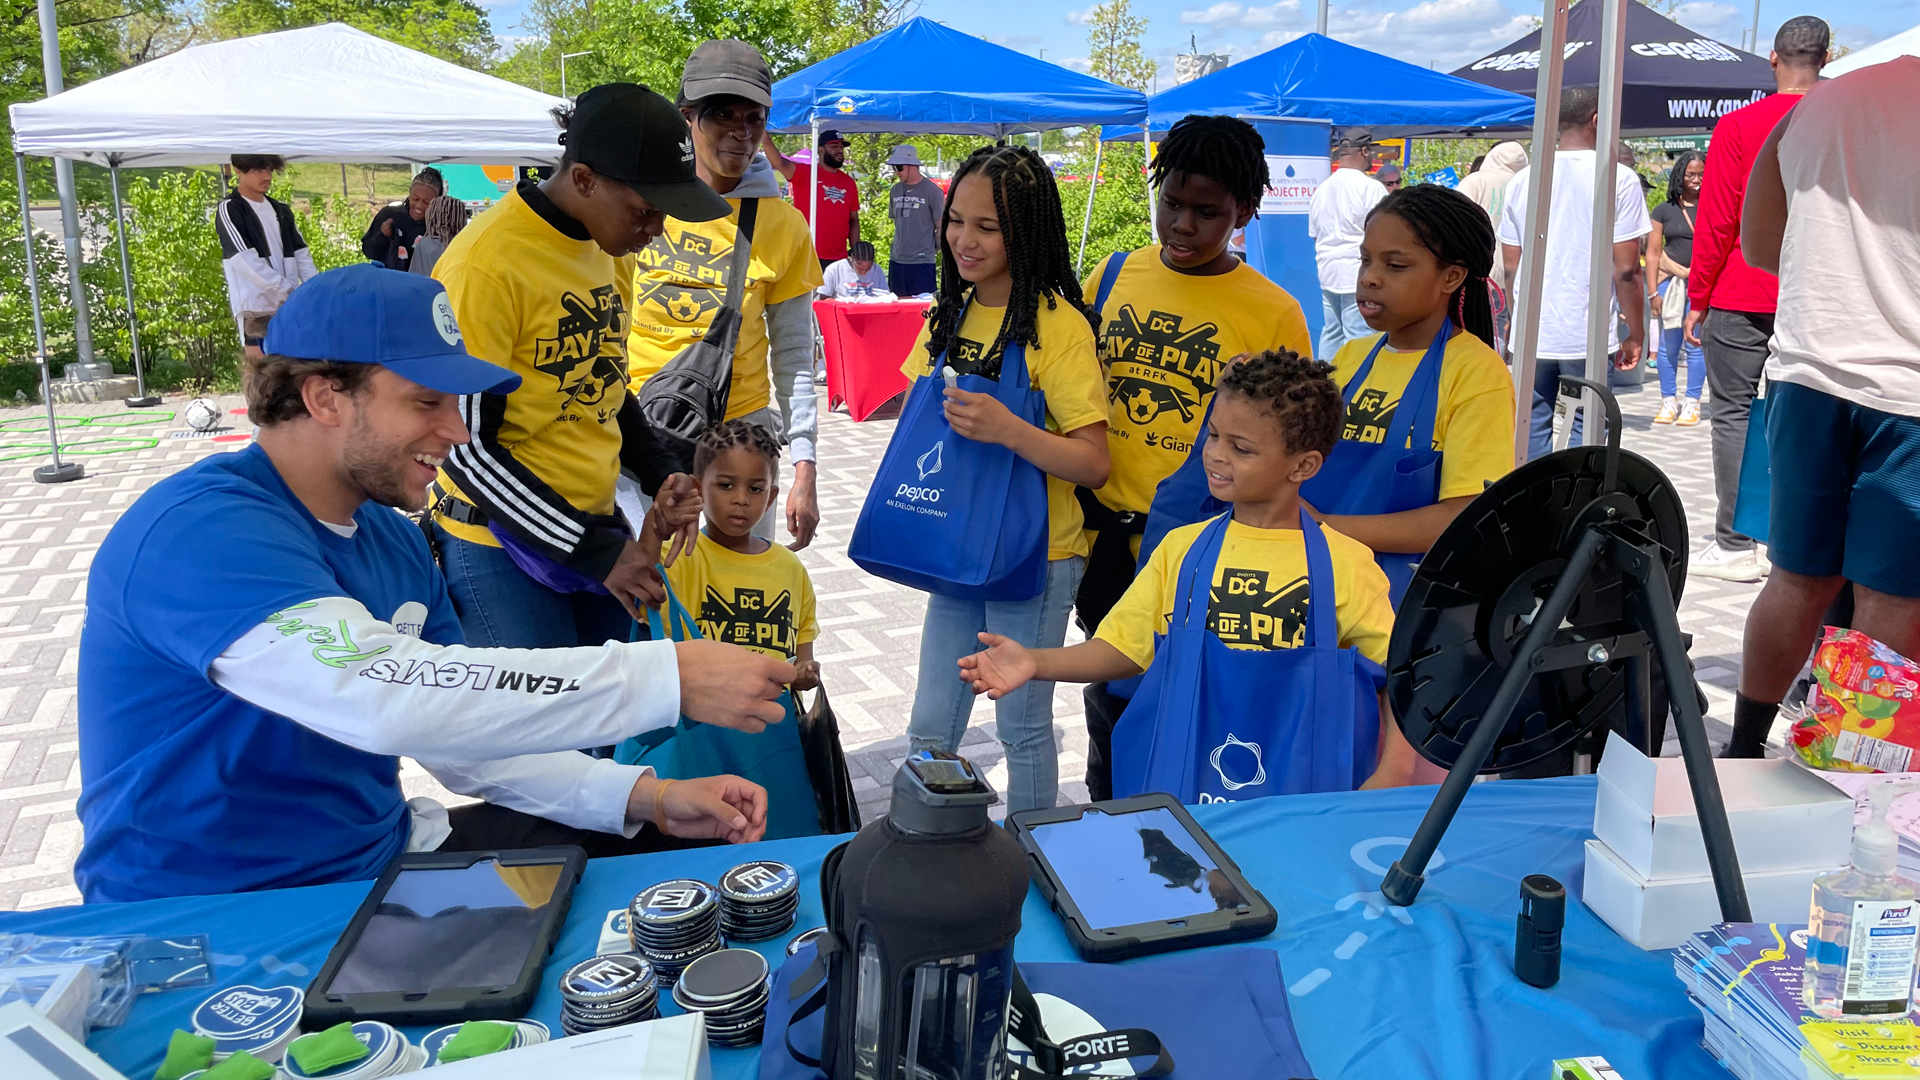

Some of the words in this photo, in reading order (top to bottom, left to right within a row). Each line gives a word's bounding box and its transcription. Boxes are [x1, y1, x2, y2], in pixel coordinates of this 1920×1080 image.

[1630, 38, 1730, 60] capelli
[1691, 53, 1743, 62] SPORT
[1263, 187, 1299, 197] PROJECT
[1301, 187, 1317, 197] PLA
[684, 238, 707, 255] DC
[638, 247, 669, 266] AY
[673, 262, 690, 273] OF
[664, 327, 675, 335] By
[1150, 317, 1175, 334] DC
[536, 330, 593, 367] DAY
[957, 345, 978, 362] DC
[1100, 336, 1134, 358] AY
[1136, 345, 1154, 360] OF
[1129, 366, 1140, 374] at
[1143, 369, 1167, 381] RFK
[1121, 431, 1130, 439] By
[1161, 436, 1194, 453] Gian
[895, 483, 940, 502] pepco
[895, 501, 916, 512] EXELON
[916, 506, 948, 518] COMPANY
[1228, 577, 1260, 596] DC
[740, 595, 761, 610] DC
[701, 620, 728, 641] AY
[735, 625, 749, 639] OF
[756, 622, 798, 654] PLAY
[1219, 616, 1240, 636] OF
[1250, 612, 1306, 649] PLA
[495, 669, 581, 695] TEAM
[1884, 908, 1908, 918] Purell
[580, 987, 628, 998] Metrobus
[227, 994, 260, 1010] BUS
[210, 1001, 257, 1026] BETTER
[1857, 1042, 1920, 1050] Discover
[1856, 1054, 1903, 1063] Share
